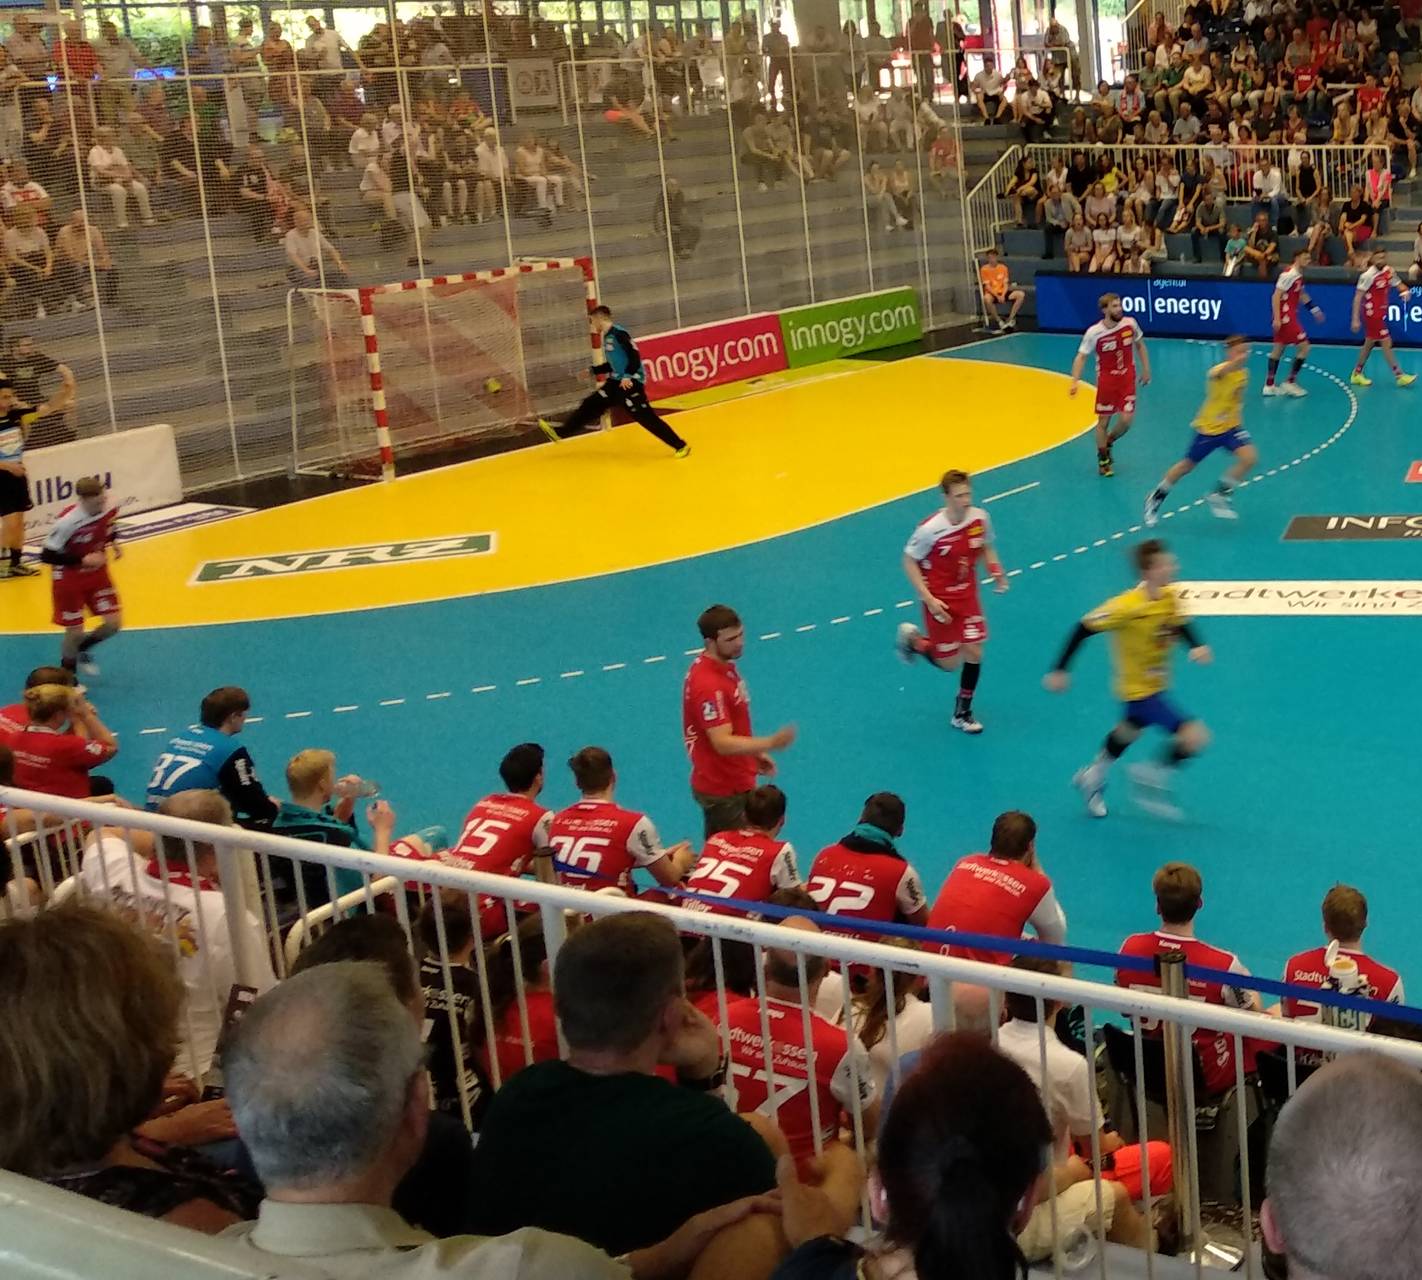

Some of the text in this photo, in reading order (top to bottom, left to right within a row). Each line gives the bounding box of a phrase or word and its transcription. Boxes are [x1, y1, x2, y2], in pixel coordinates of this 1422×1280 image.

[788, 303, 917, 351] innogy.com
[1121, 295, 1222, 321] on energy
[641, 332, 779, 382] nnogy.com
[217, 537, 479, 579] NRZ
[1287, 599, 1329, 609] Wir
[1340, 599, 1397, 609] sind
[452, 817, 512, 857] 15
